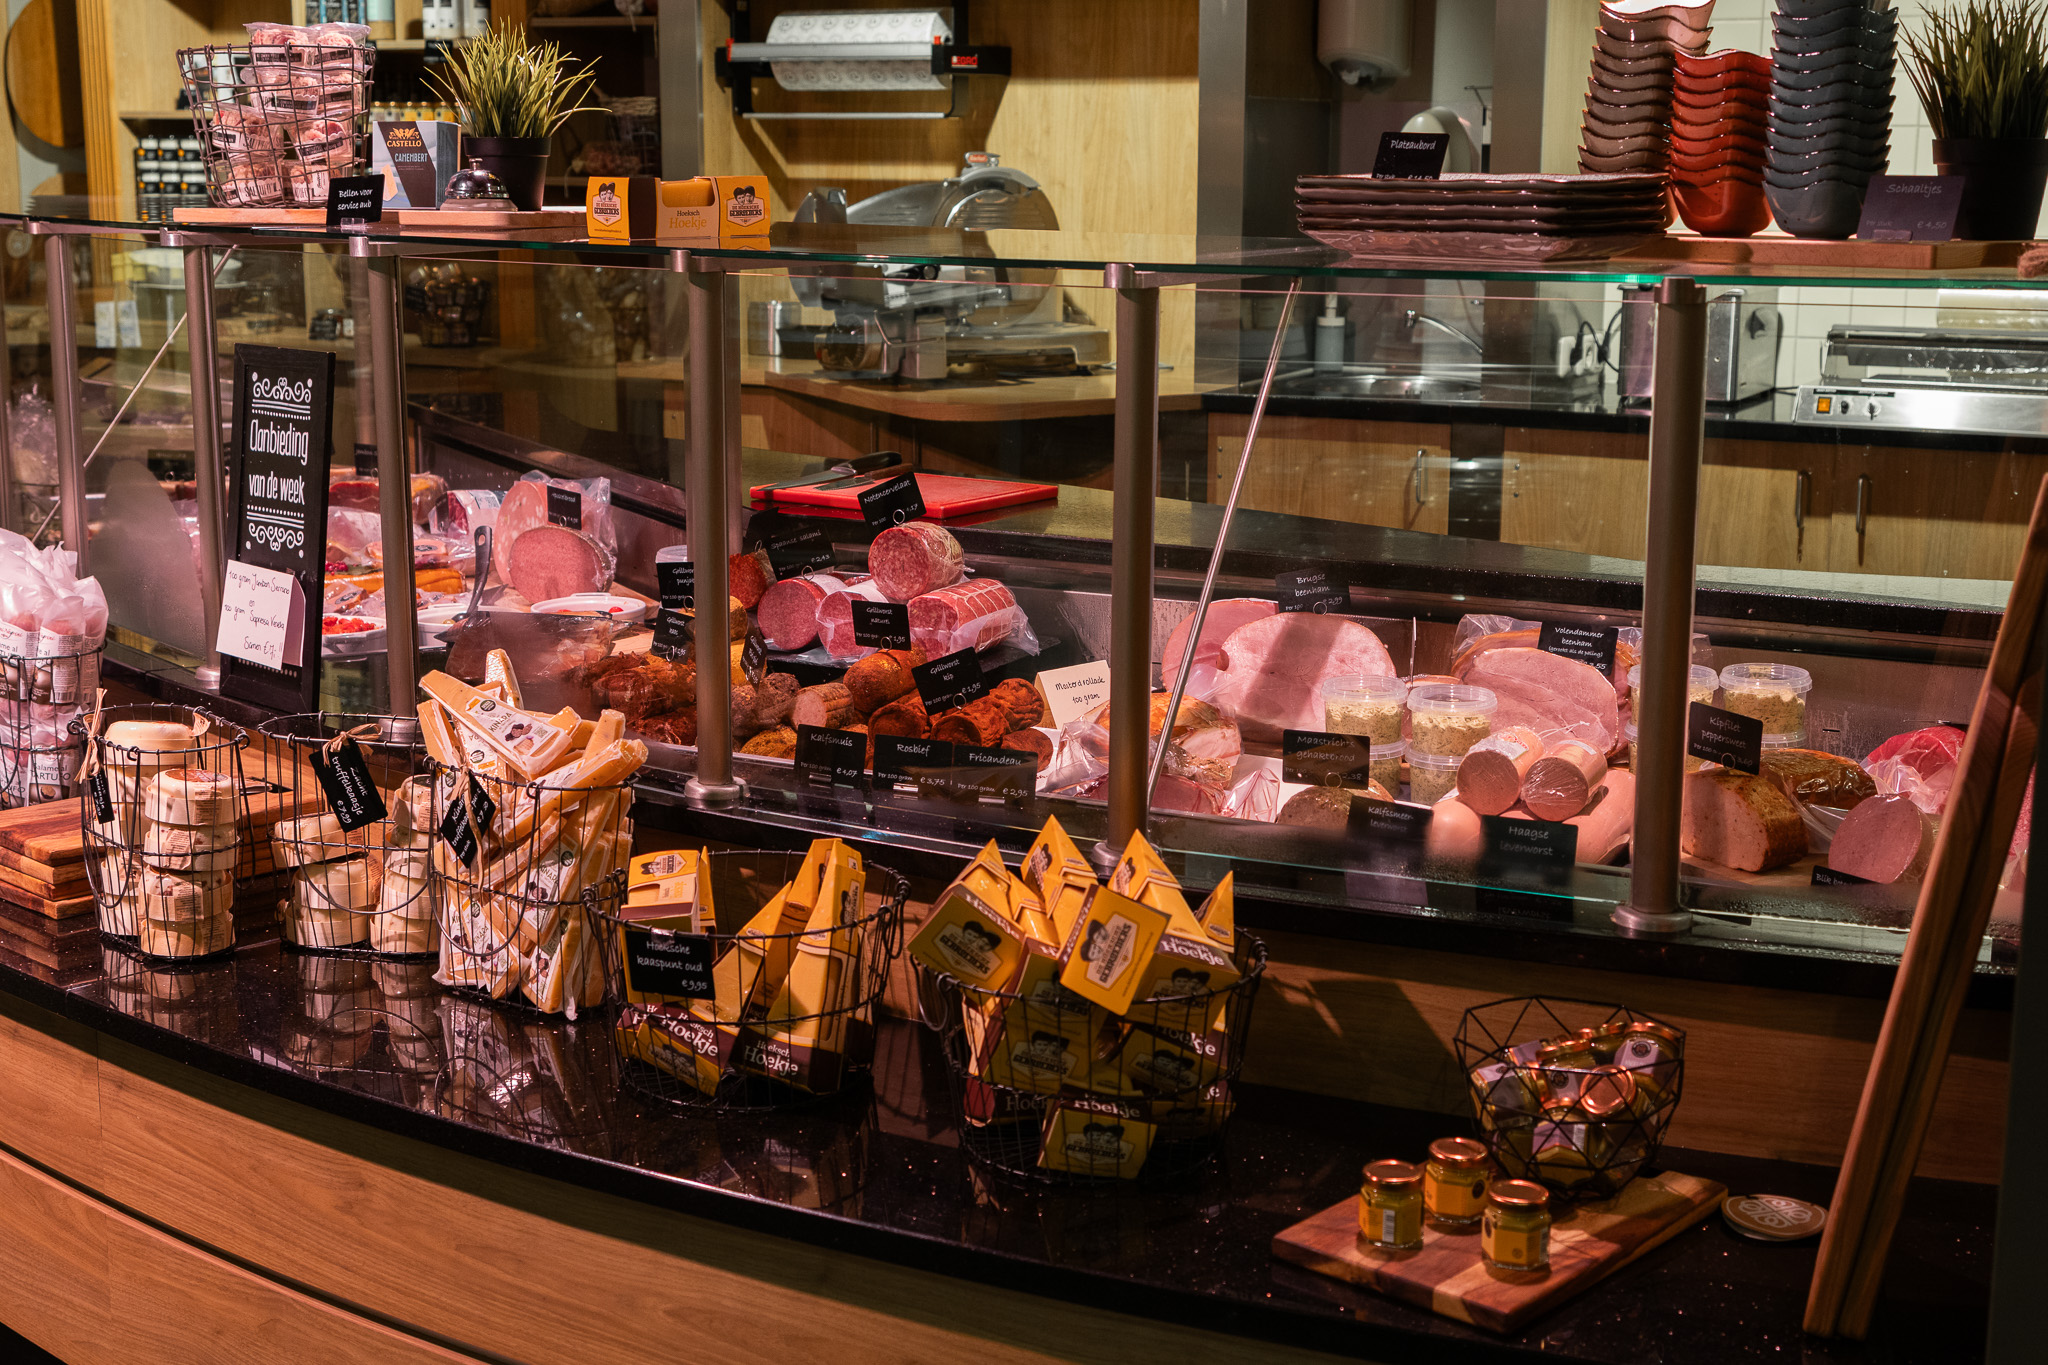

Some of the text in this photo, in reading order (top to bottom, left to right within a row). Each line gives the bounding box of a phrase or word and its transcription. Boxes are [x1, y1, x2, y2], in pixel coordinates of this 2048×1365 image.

[1390, 140, 1436, 150] Plateaubord
[394, 153, 428, 162] CAMEMBERT
[338, 188, 373, 198] Bellen voor
[1886, 182, 1942, 198] Schaaltjes
[337, 200, 372, 210] service aub
[669, 217, 707, 230] Hoekje
[250, 419, 309, 466] Aanbieding
[249, 471, 305, 505] van de week
[864, 480, 911, 504] Notencervelaat
[1296, 573, 1326, 584] Brugse
[1294, 586, 1330, 596] beenham
[1555, 627, 1604, 638] Volendammer
[1561, 637, 1592, 647] beenham
[930, 659, 960, 674] Grillworst
[943, 673, 954, 682] kip
[1709, 716, 1741, 732] Kipfilet
[810, 733, 853, 747] Kalfsmuis
[897, 744, 931, 757] Rosbief
[969, 753, 1022, 766] Fricandeau
[331, 756, 364, 816] truffelkaasje
[1508, 826, 1549, 840] Haagse
[1161, 940, 1225, 966] Hoekje
[637, 955, 703, 973] kaaspunt oud
